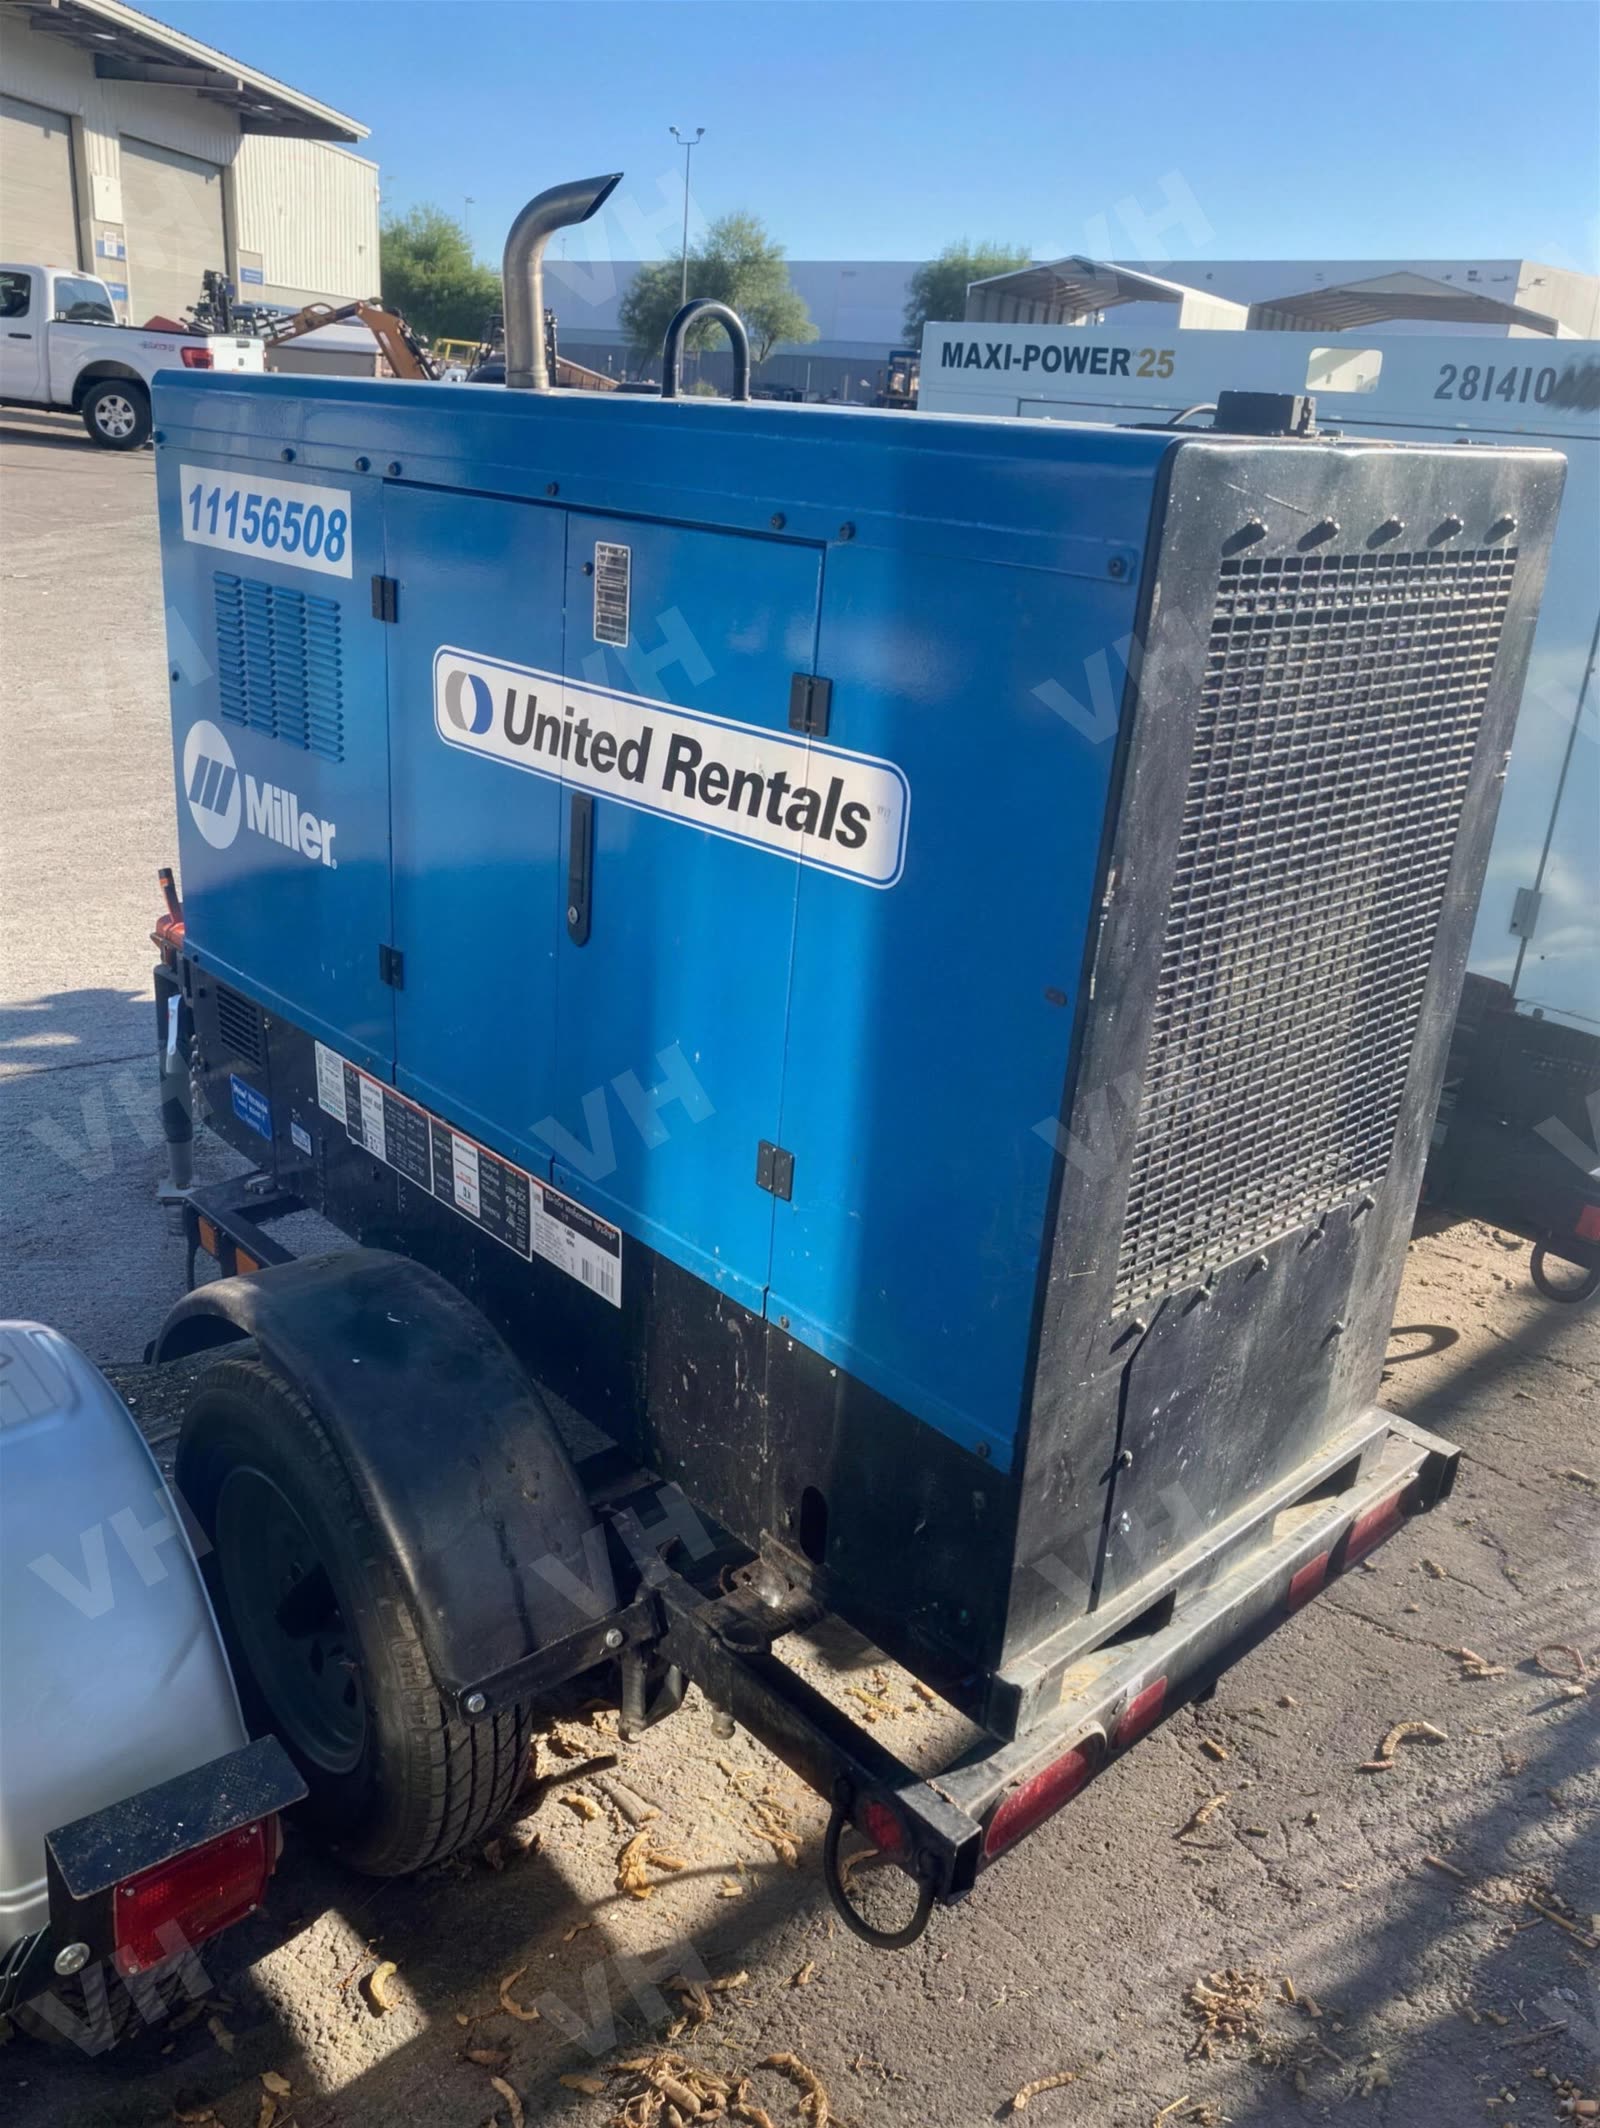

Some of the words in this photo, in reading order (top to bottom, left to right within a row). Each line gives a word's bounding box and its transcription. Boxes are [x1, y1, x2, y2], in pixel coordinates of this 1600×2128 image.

[941, 341, 1131, 377] MAXI-POWER
[1136, 347, 1176, 379] 25
[1433, 363, 1600, 412] 281410
[189, 484, 347, 562] 11156508
[503, 687, 653, 784] United
[662, 733, 871, 849] Rentals
